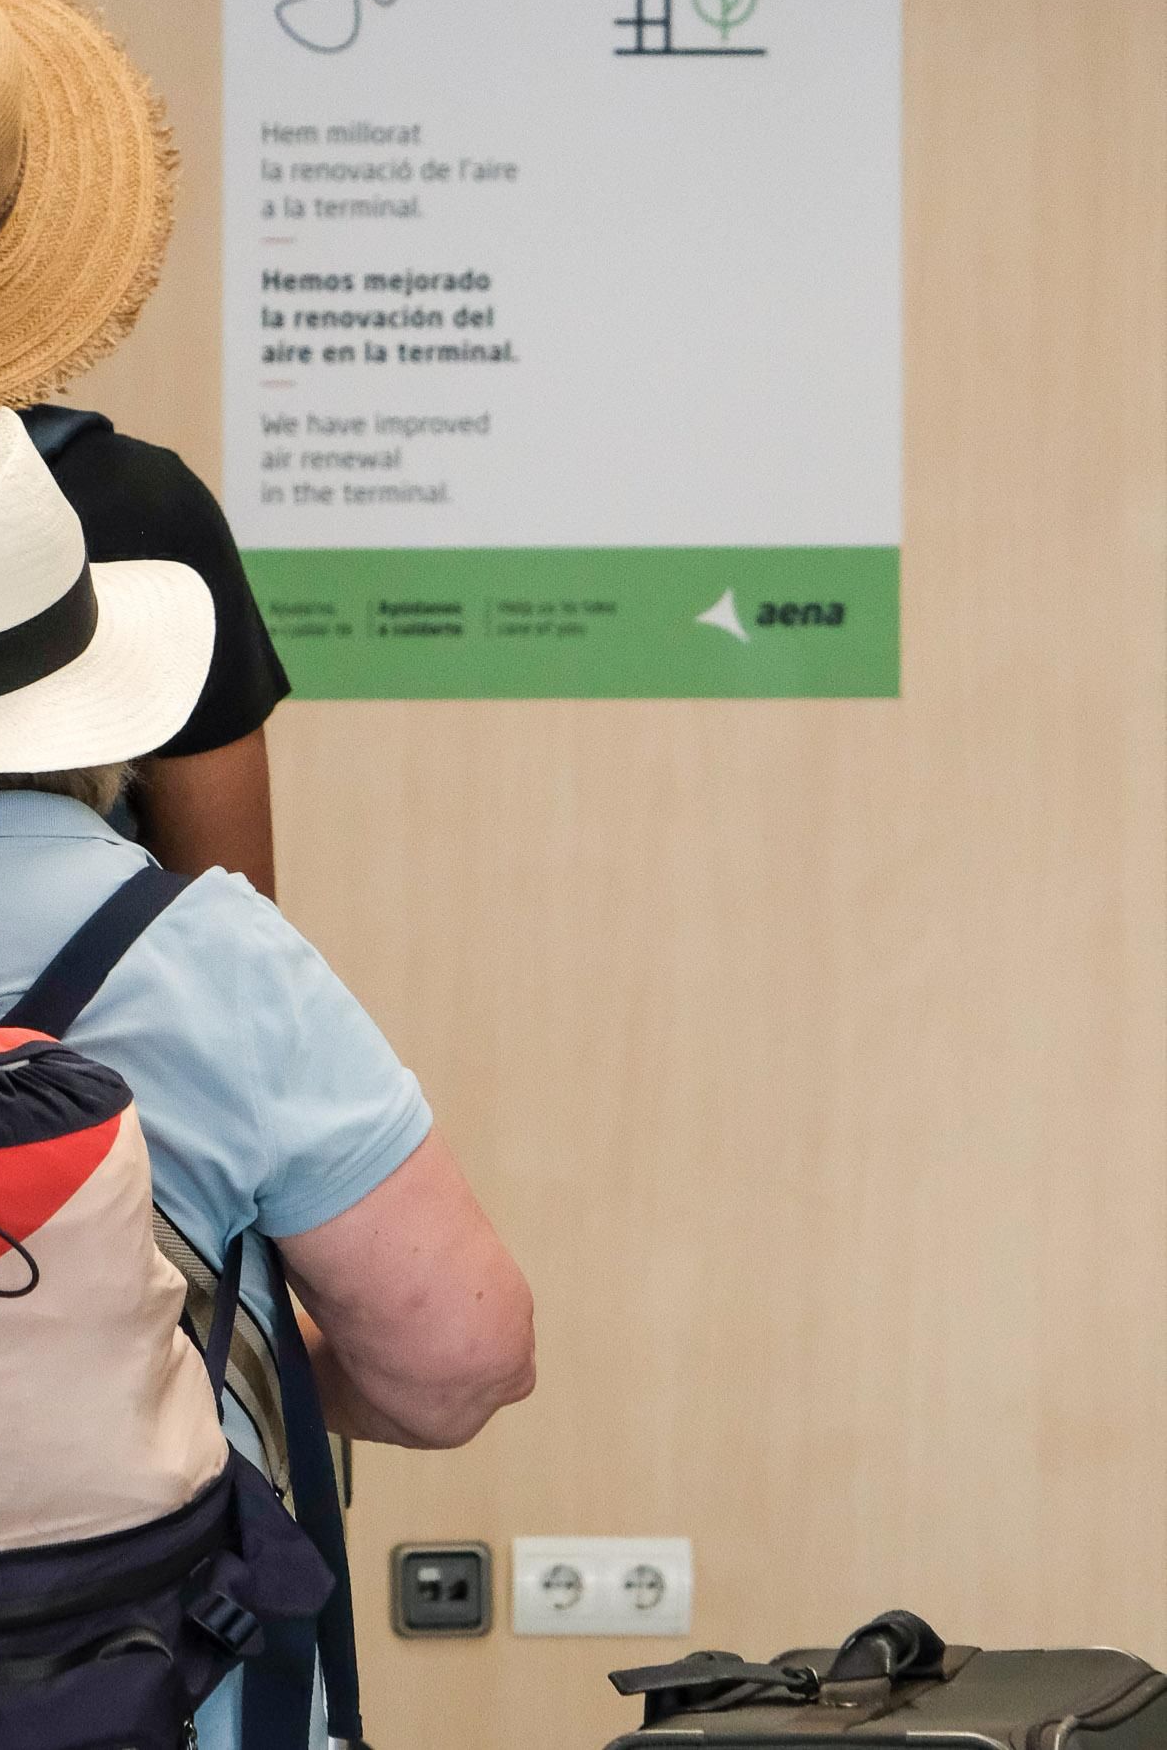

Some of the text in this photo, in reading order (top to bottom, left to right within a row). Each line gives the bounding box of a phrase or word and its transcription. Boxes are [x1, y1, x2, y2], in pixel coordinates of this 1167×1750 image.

[261, 122, 319, 145] Hem
[261, 161, 283, 182] la
[290, 158, 412, 182] renovació
[420, 161, 451, 181] de
[262, 201, 276, 219] a
[284, 198, 305, 218] la
[262, 269, 491, 297] Hemos mejorado
[261, 305, 495, 329] la renovación del
[261, 340, 518, 365] aire en la terminal.
[262, 413, 490, 438] We have improved
[261, 447, 401, 470] air renewal
[756, 602, 845, 627] aena
